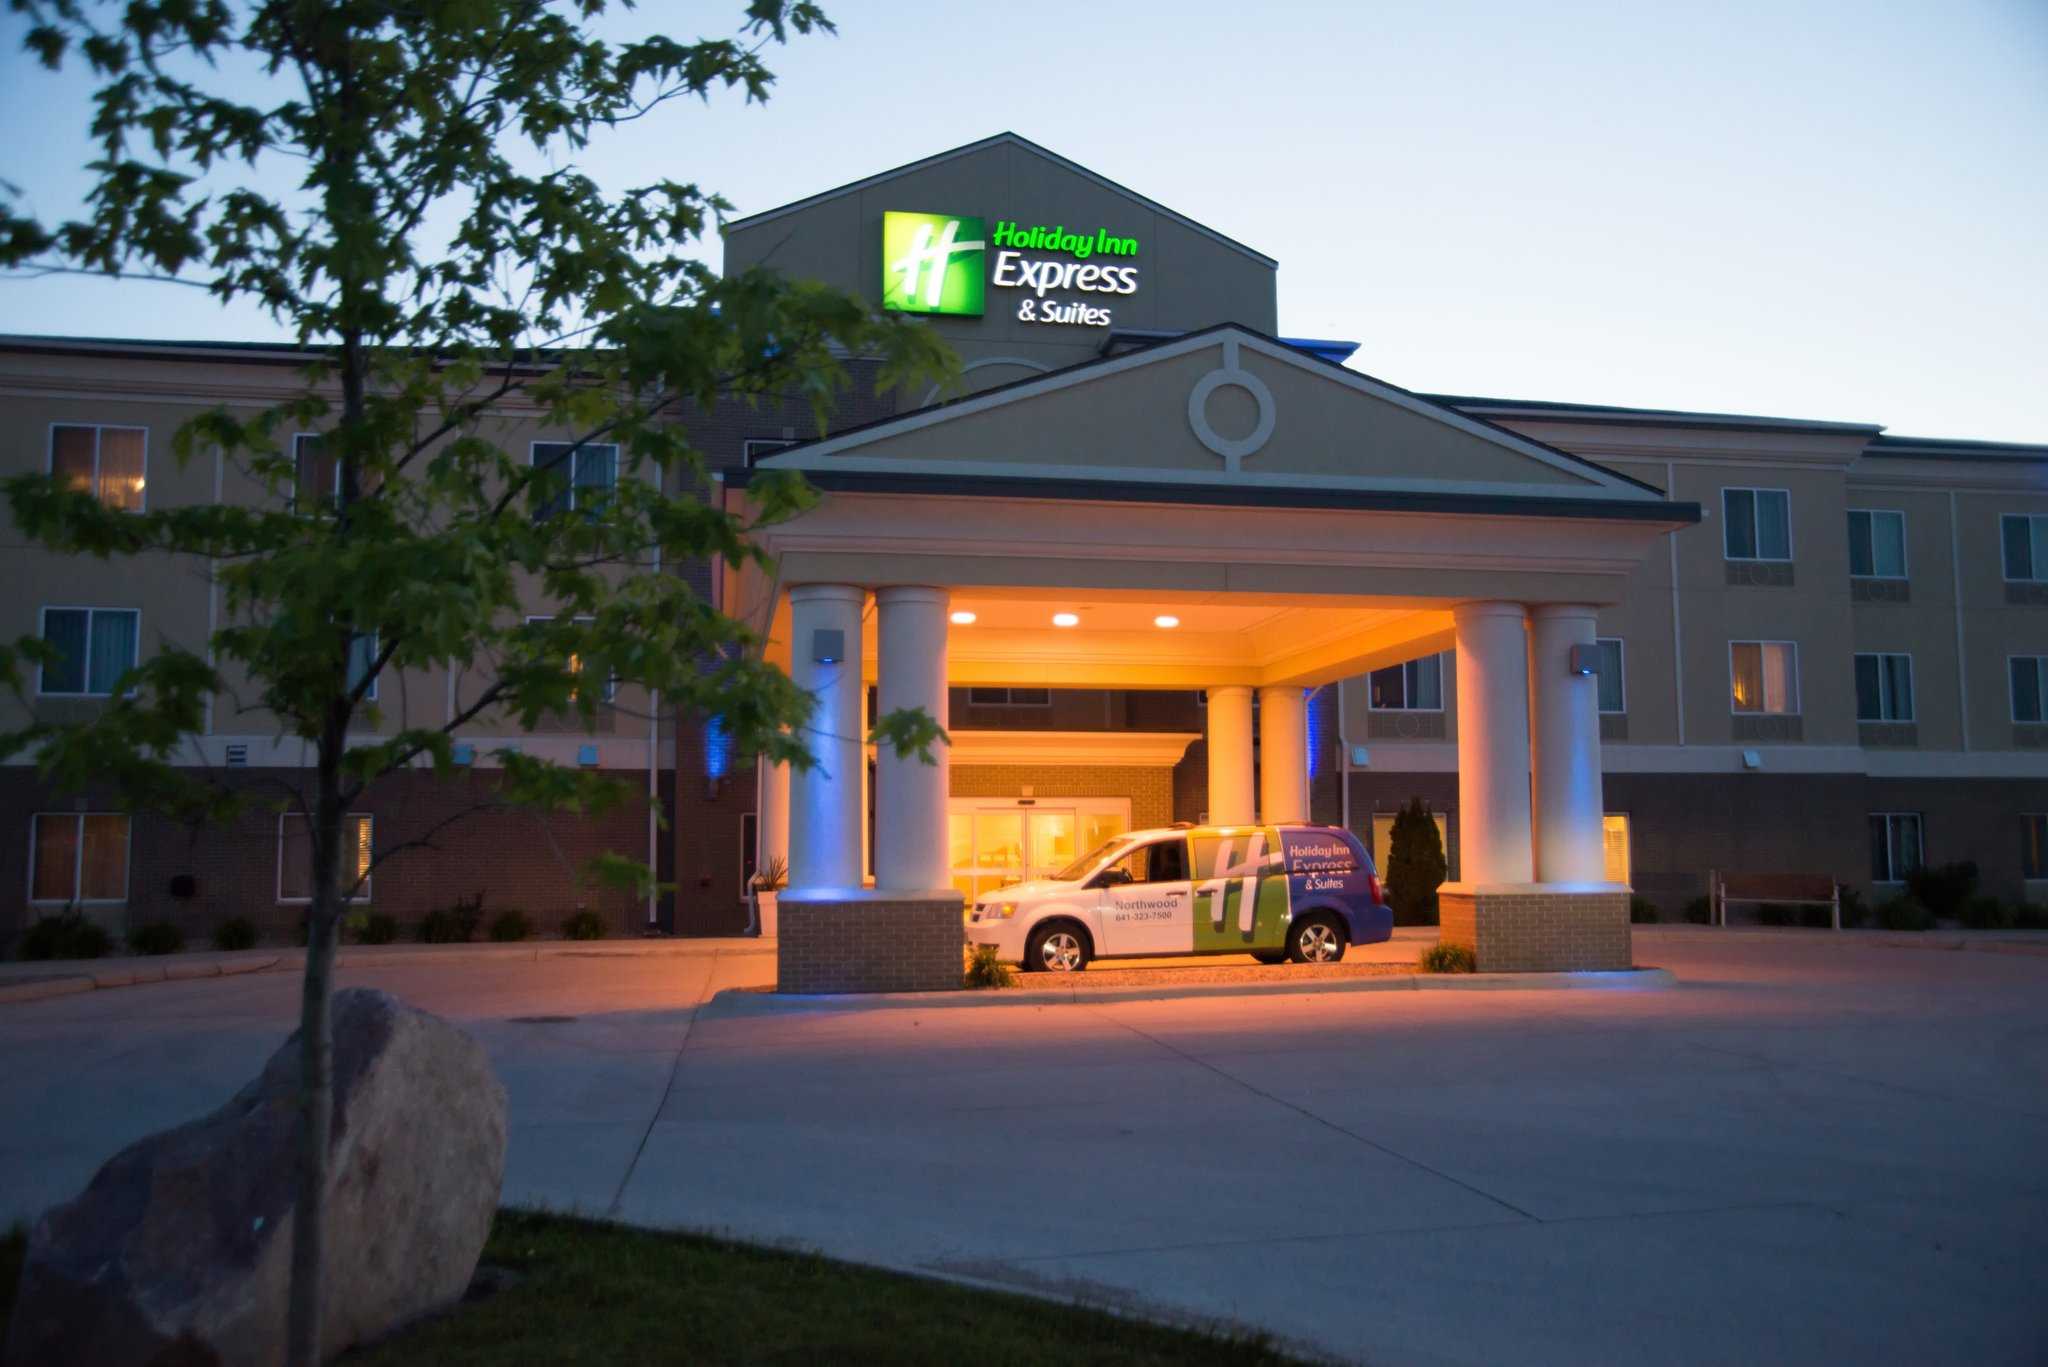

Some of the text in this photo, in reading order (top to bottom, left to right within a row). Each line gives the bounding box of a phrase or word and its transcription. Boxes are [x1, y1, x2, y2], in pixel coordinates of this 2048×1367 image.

[993, 221, 1137, 258] Holiday Inn
[993, 251, 1138, 298] Express
[1018, 299, 1111, 326] & Suites
[1290, 842, 1350, 858] Holiday Inn
[1293, 860, 1352, 878] Express
[1305, 879, 1344, 890] & Suites
[1115, 898, 1178, 911] Northwood
